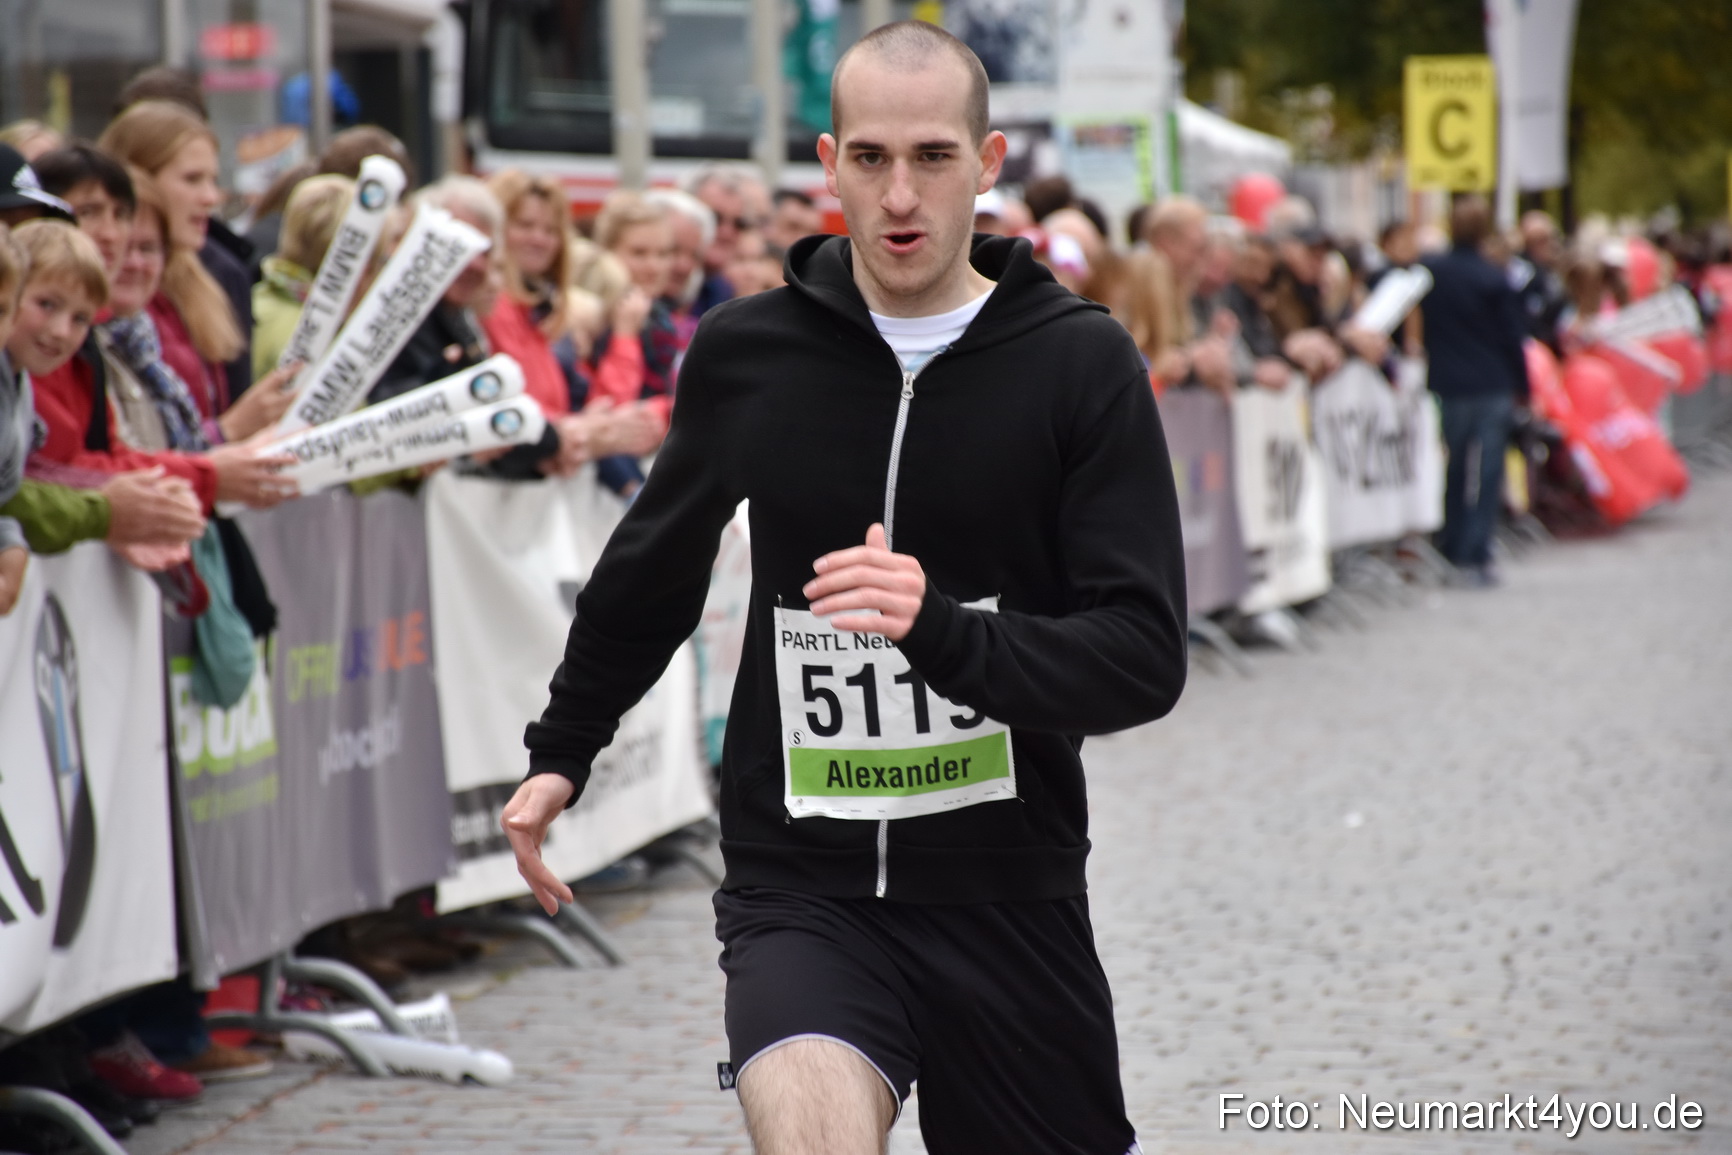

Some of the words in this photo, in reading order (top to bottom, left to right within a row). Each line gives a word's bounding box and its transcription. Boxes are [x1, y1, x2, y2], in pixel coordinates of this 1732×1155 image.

[1426, 98, 1471, 161] C
[320, 227, 369, 302] BMW
[297, 357, 358, 426] BMW
[348, 231, 447, 350] Laufsport
[781, 630, 848, 651] PARTL
[853, 632, 896, 650] Neu
[825, 756, 972, 789] Alexander
